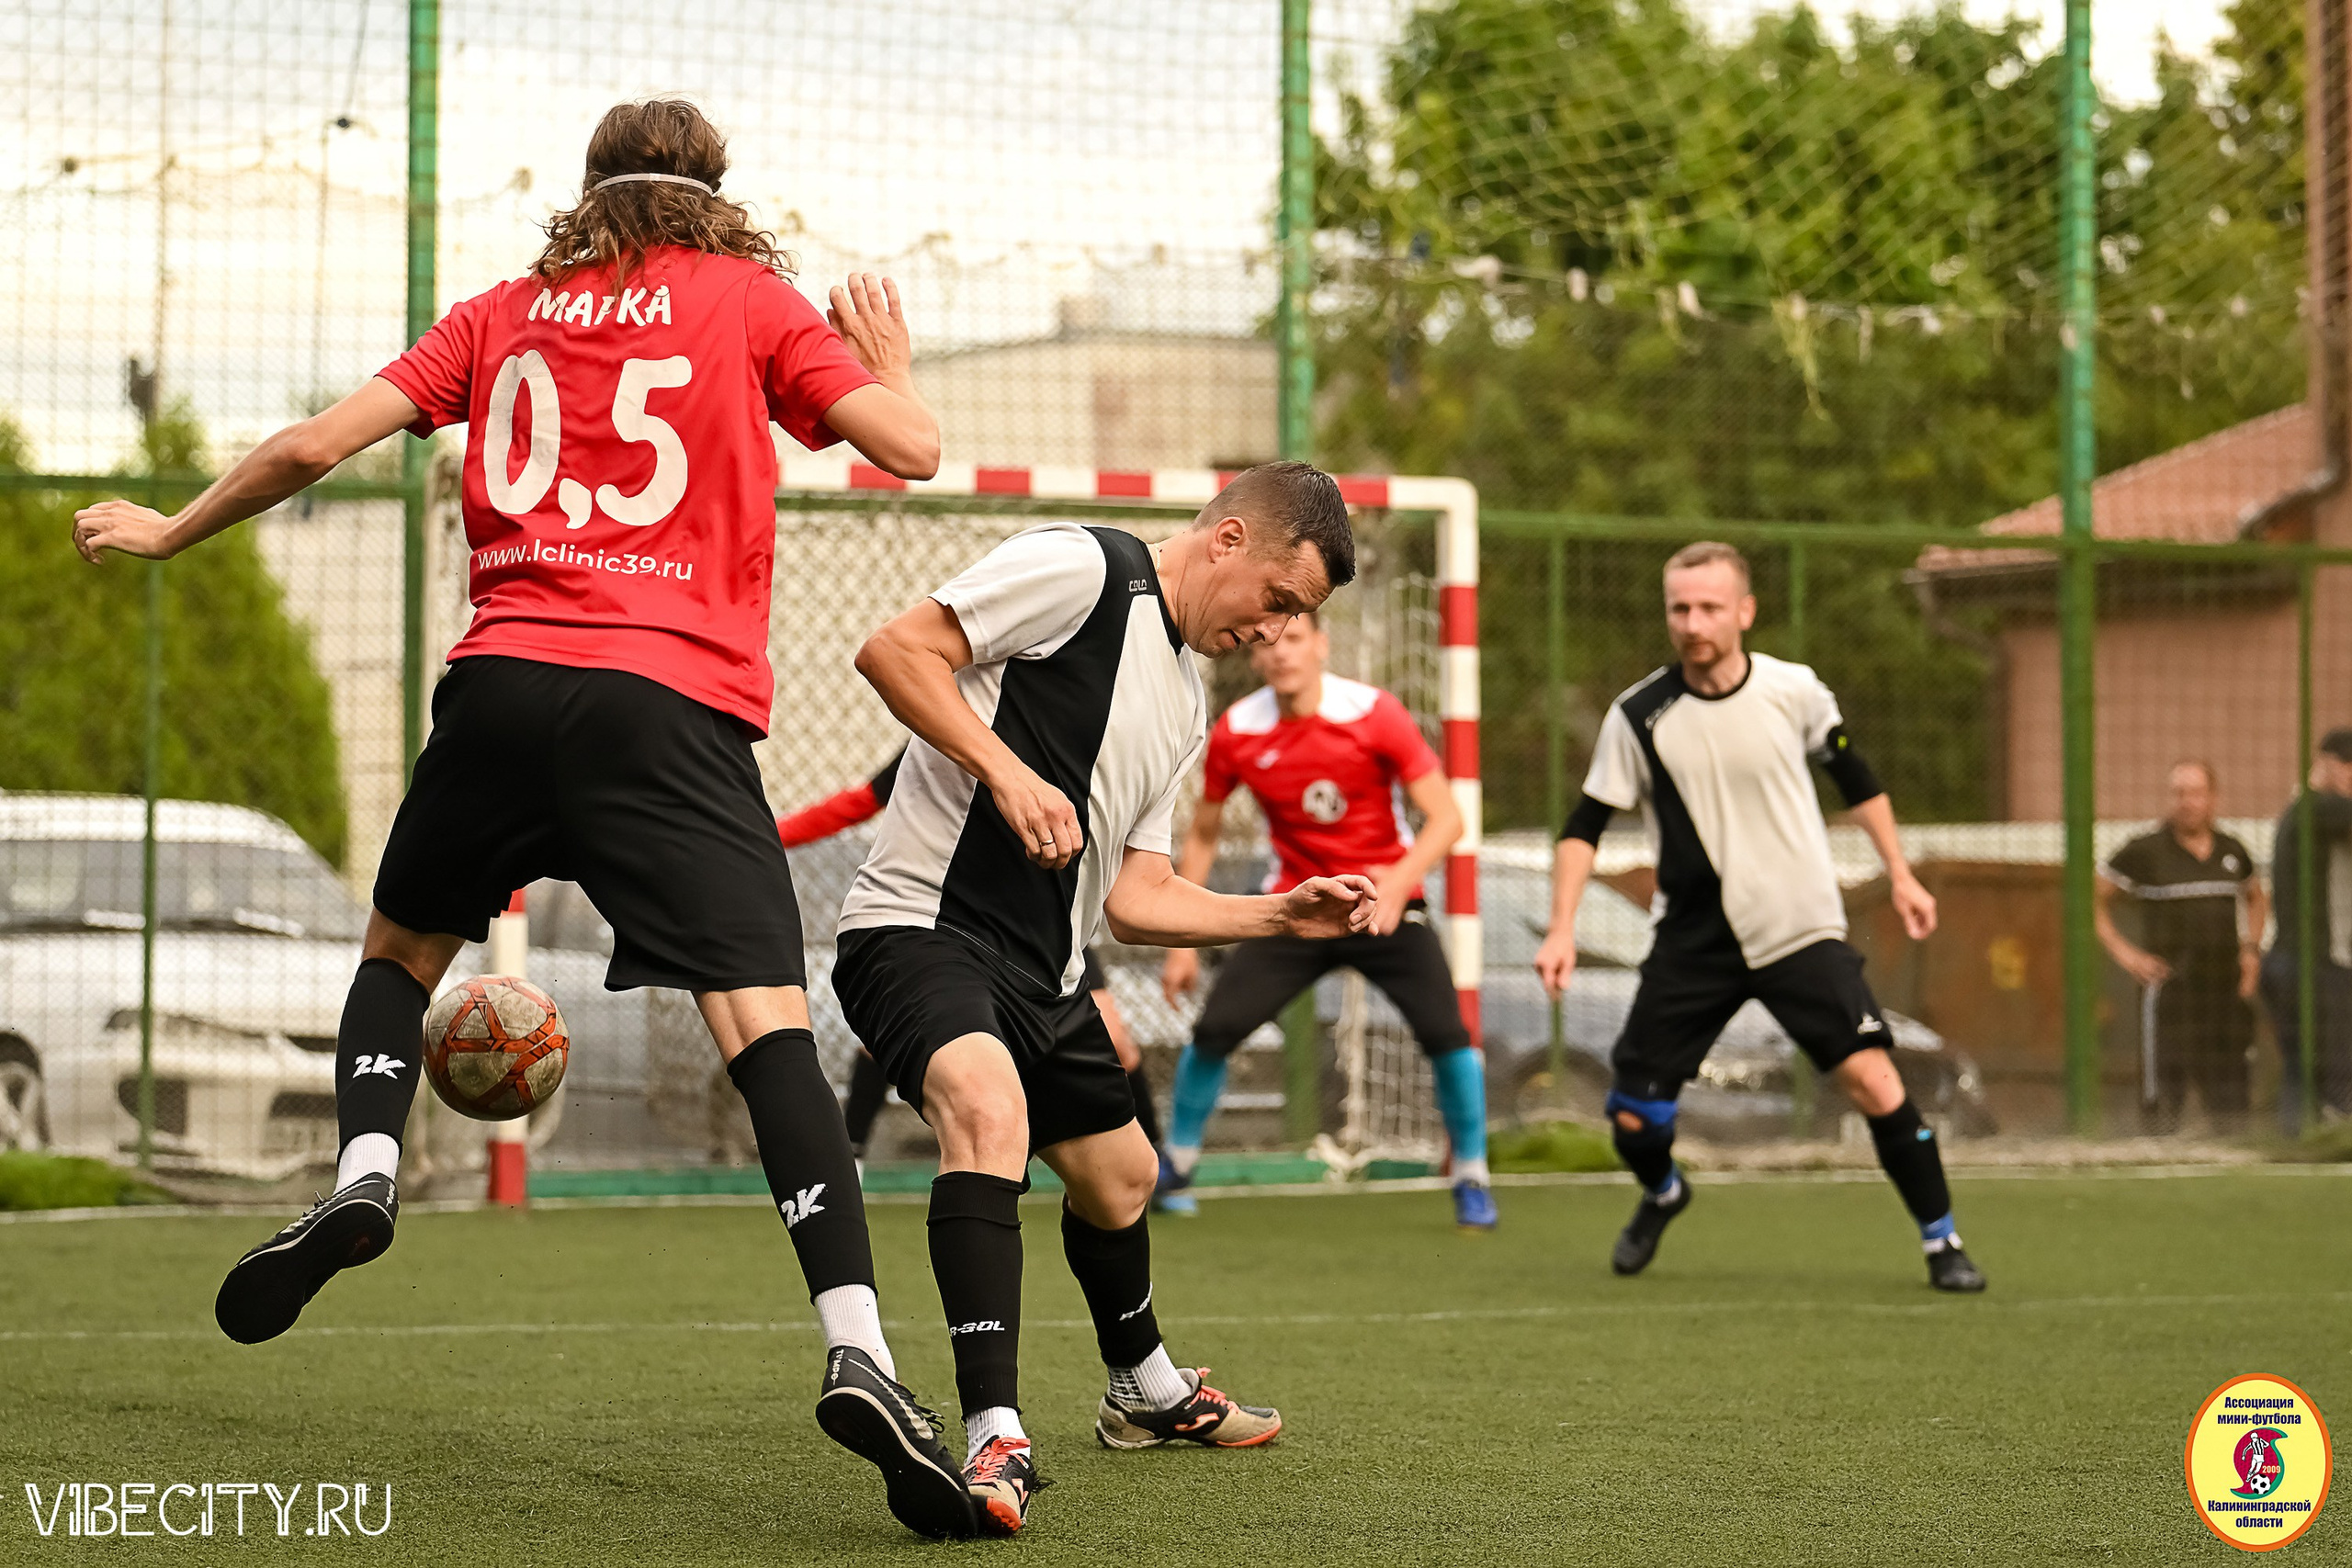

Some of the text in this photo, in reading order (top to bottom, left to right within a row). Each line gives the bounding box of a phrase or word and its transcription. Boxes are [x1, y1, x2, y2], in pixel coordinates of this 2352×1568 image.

[483, 349, 693, 530] 0,5
[478, 538, 693, 581] www.lclinic39.ru
[352, 1053, 406, 1079] 2K
[780, 1182, 827, 1229] 2K
